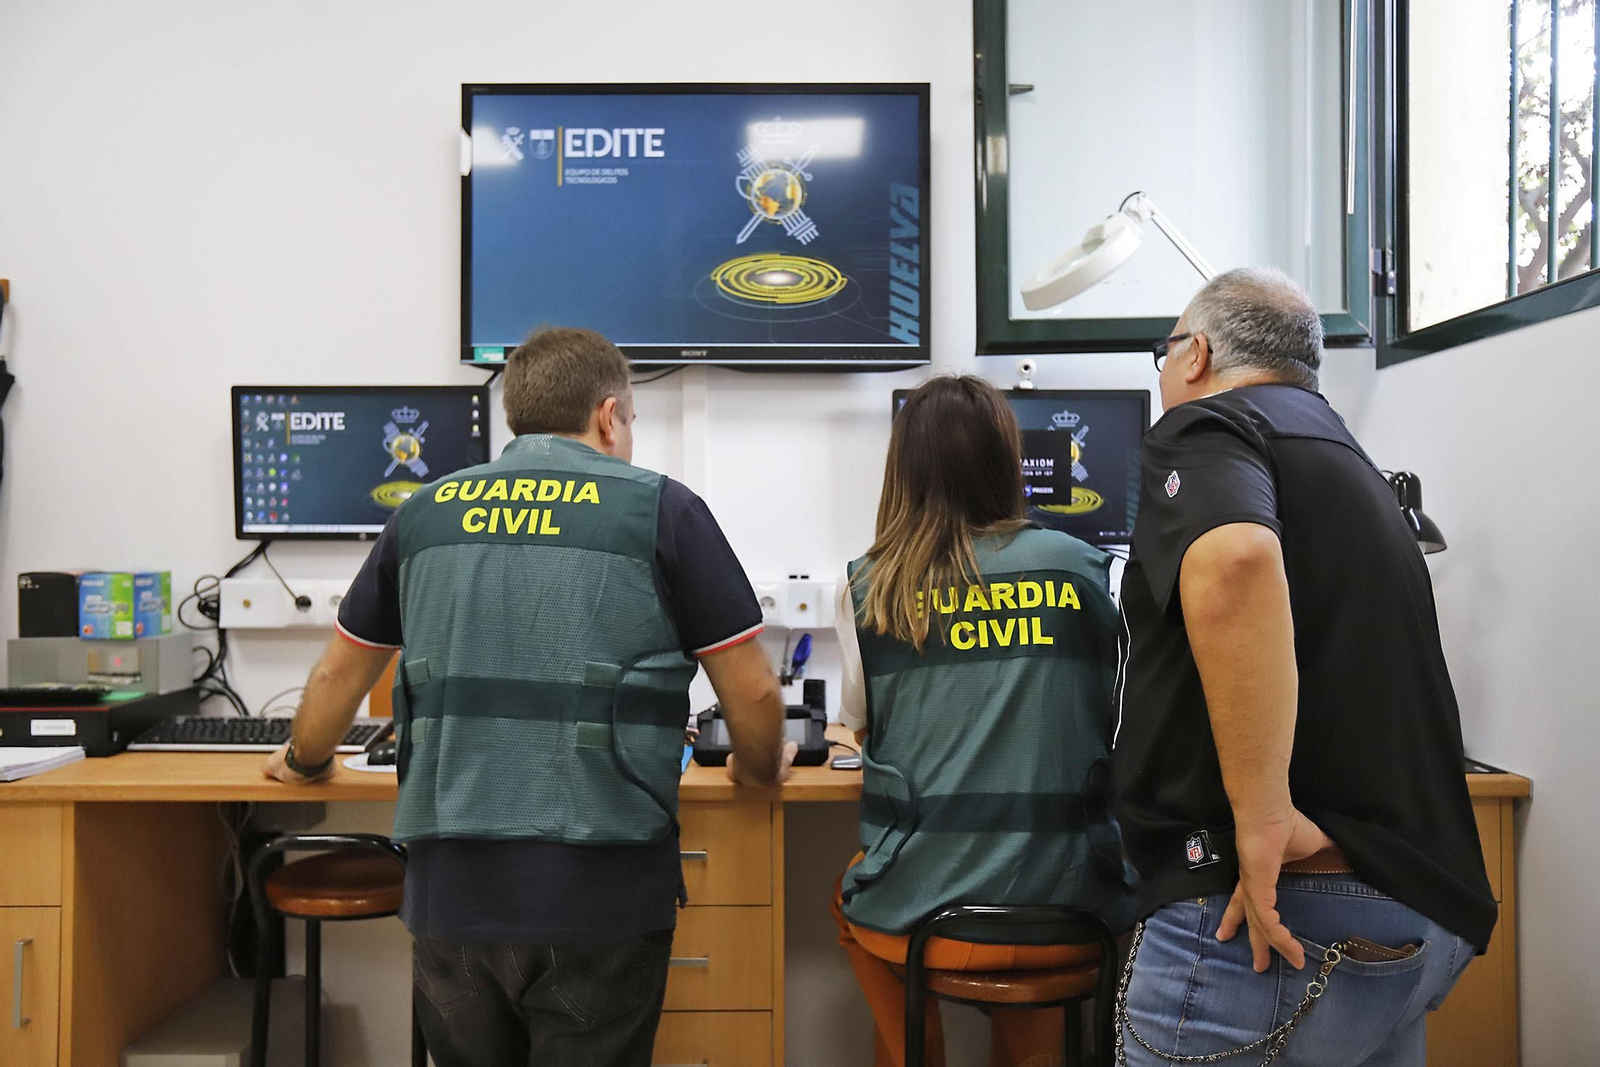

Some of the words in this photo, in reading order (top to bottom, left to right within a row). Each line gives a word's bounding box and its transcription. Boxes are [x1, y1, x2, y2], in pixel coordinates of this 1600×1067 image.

[564, 128, 665, 158] EDITE
[889, 182, 920, 344] HUELVA
[290, 411, 346, 431] EDITE
[434, 478, 600, 504] GUARDIA
[461, 507, 561, 535] CIVIL
[950, 616, 1054, 650] CIVIL
